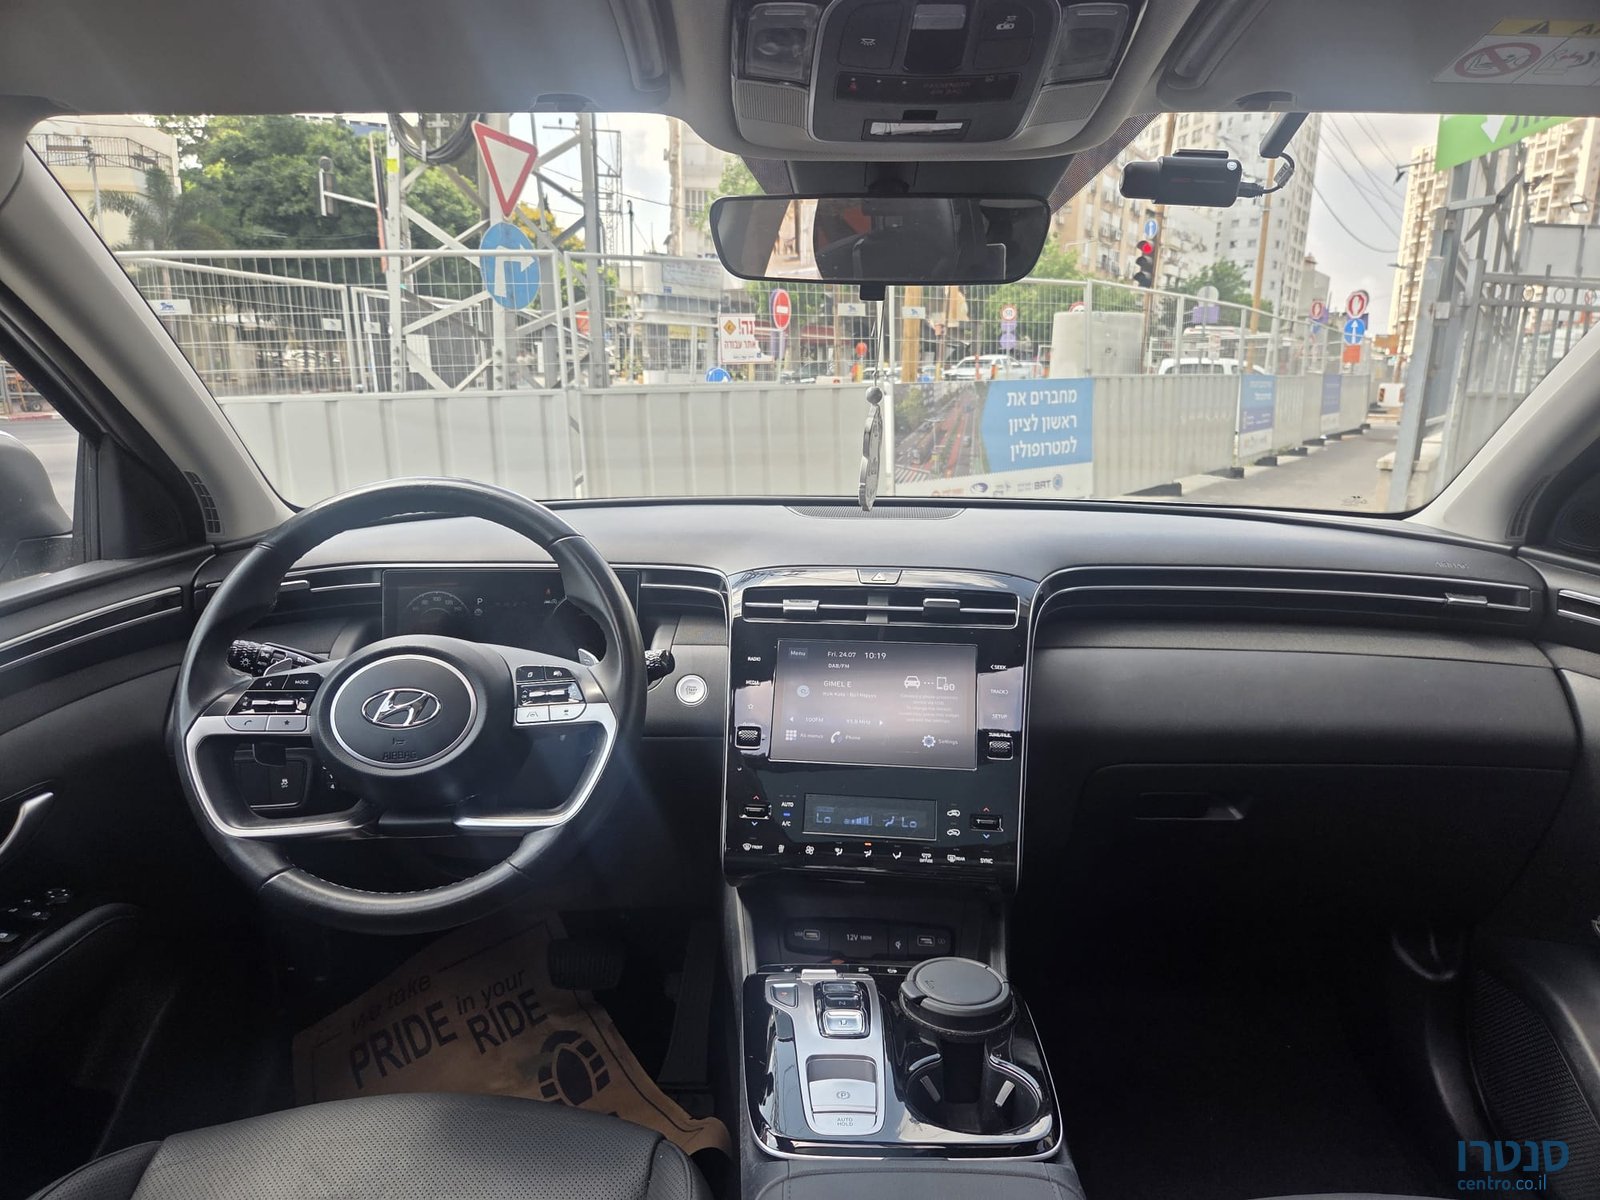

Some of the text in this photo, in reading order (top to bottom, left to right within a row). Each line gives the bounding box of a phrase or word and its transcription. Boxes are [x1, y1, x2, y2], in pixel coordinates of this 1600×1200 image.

[1006, 389, 1077, 407] מחברים את
[1008, 412, 1077, 436] ראשון לציון
[1010, 435, 1078, 462] למטרופולין
[864, 652, 887, 660] 10:19
[938, 738, 959, 746] Settings
[815, 812, 832, 824] Lo
[901, 816, 917, 828] Lo
[846, 933, 858, 941] 12V
[455, 968, 526, 1015] in your
[466, 987, 549, 1055] RIDE
[350, 1001, 458, 1090] PRIDE
